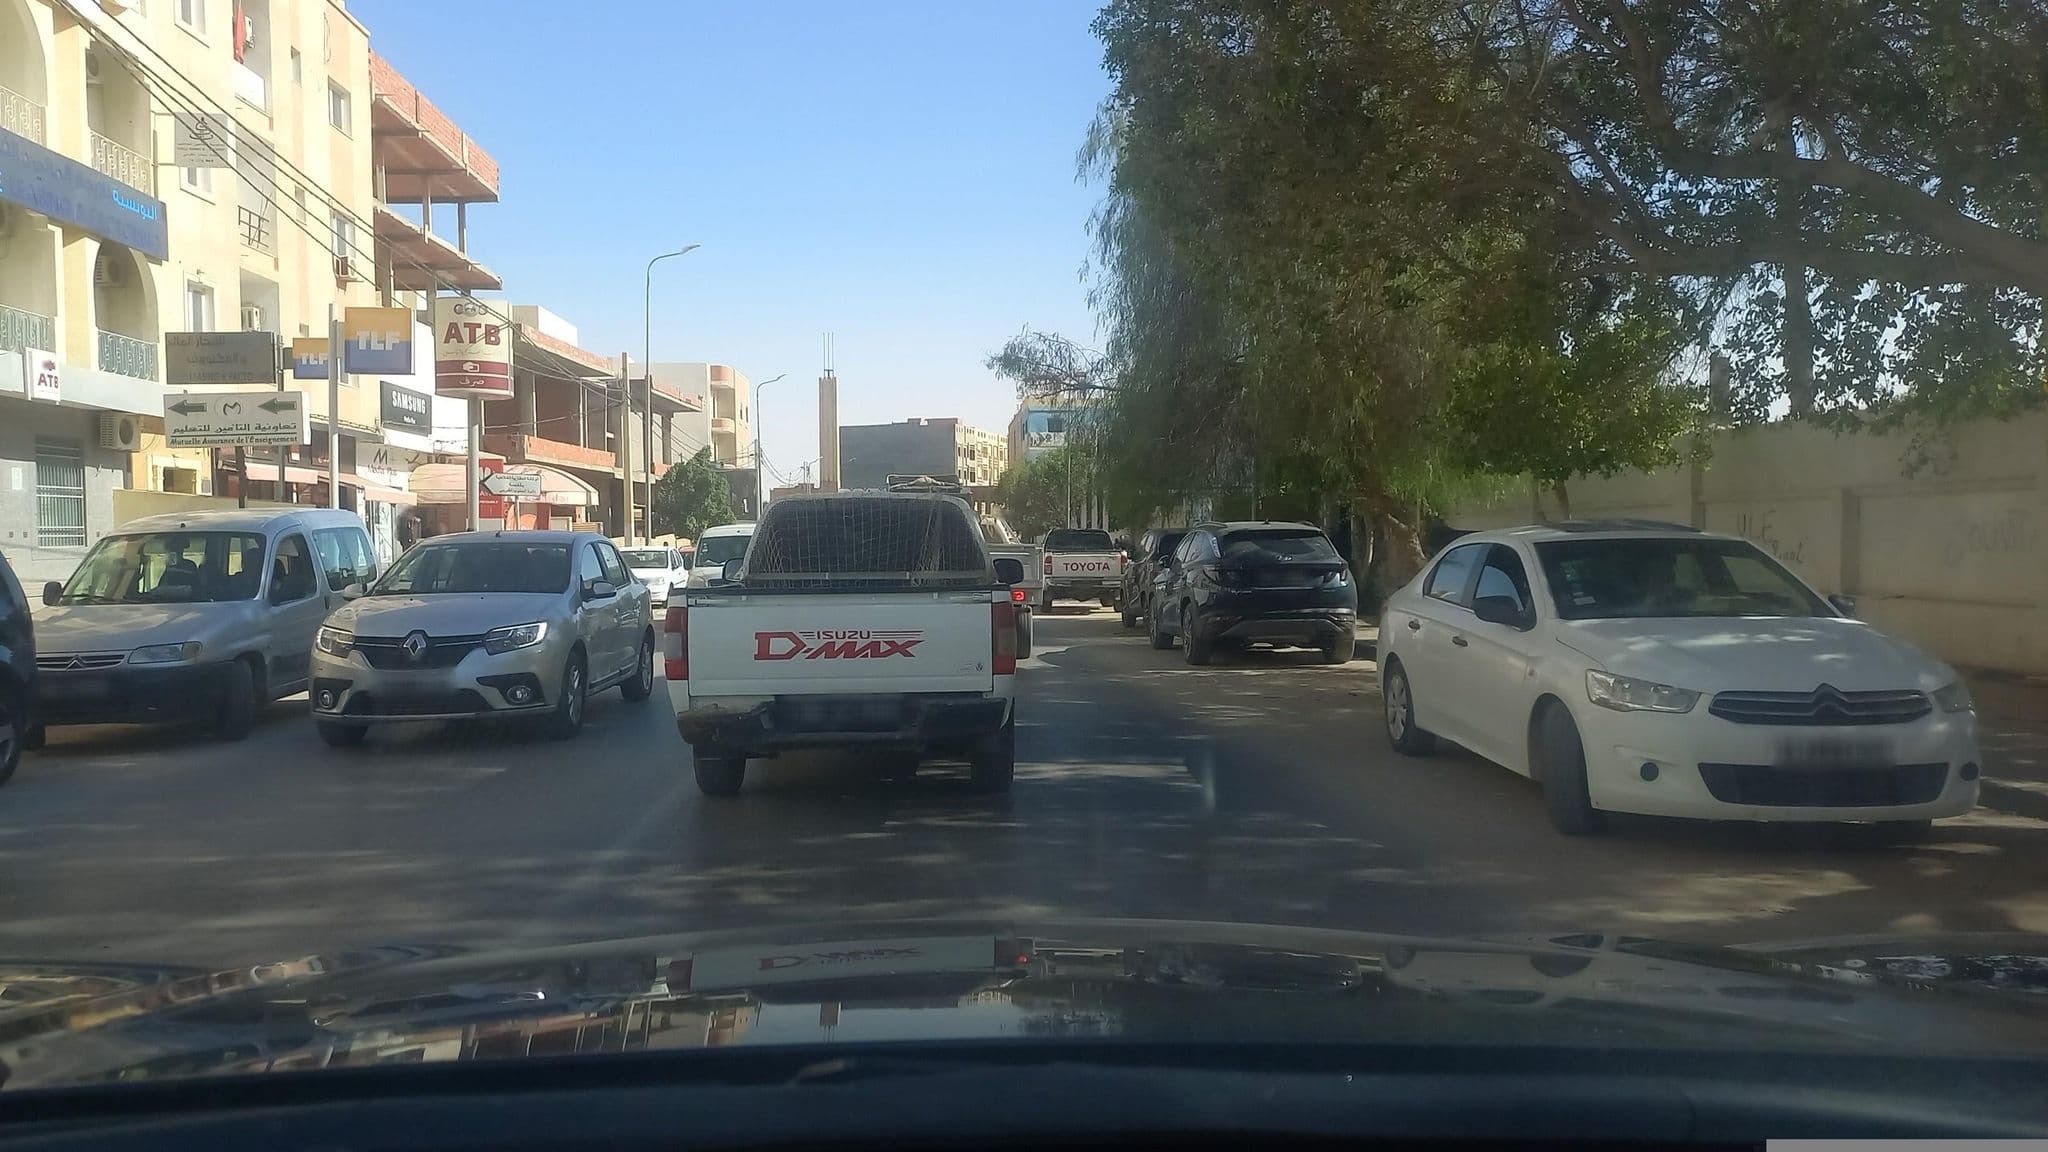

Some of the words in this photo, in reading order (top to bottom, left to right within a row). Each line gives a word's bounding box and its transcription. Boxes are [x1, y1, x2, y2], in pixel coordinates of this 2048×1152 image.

[356, 330, 400, 350] TLF
[443, 322, 501, 346] ATB
[301, 352, 328, 365] TLF
[37, 373, 59, 389] ATB
[392, 391, 426, 414] SAMSUNG
[172, 424, 211, 434] للتعليم
[254, 422, 297, 431] تعاونية
[169, 438, 201, 446] Mutuelle
[245, 435, 297, 445] l'Enseignement
[1063, 562, 1110, 572] TOYOTA
[816, 630, 871, 640] ISUZU
[753, 631, 925, 661] D-MAX
